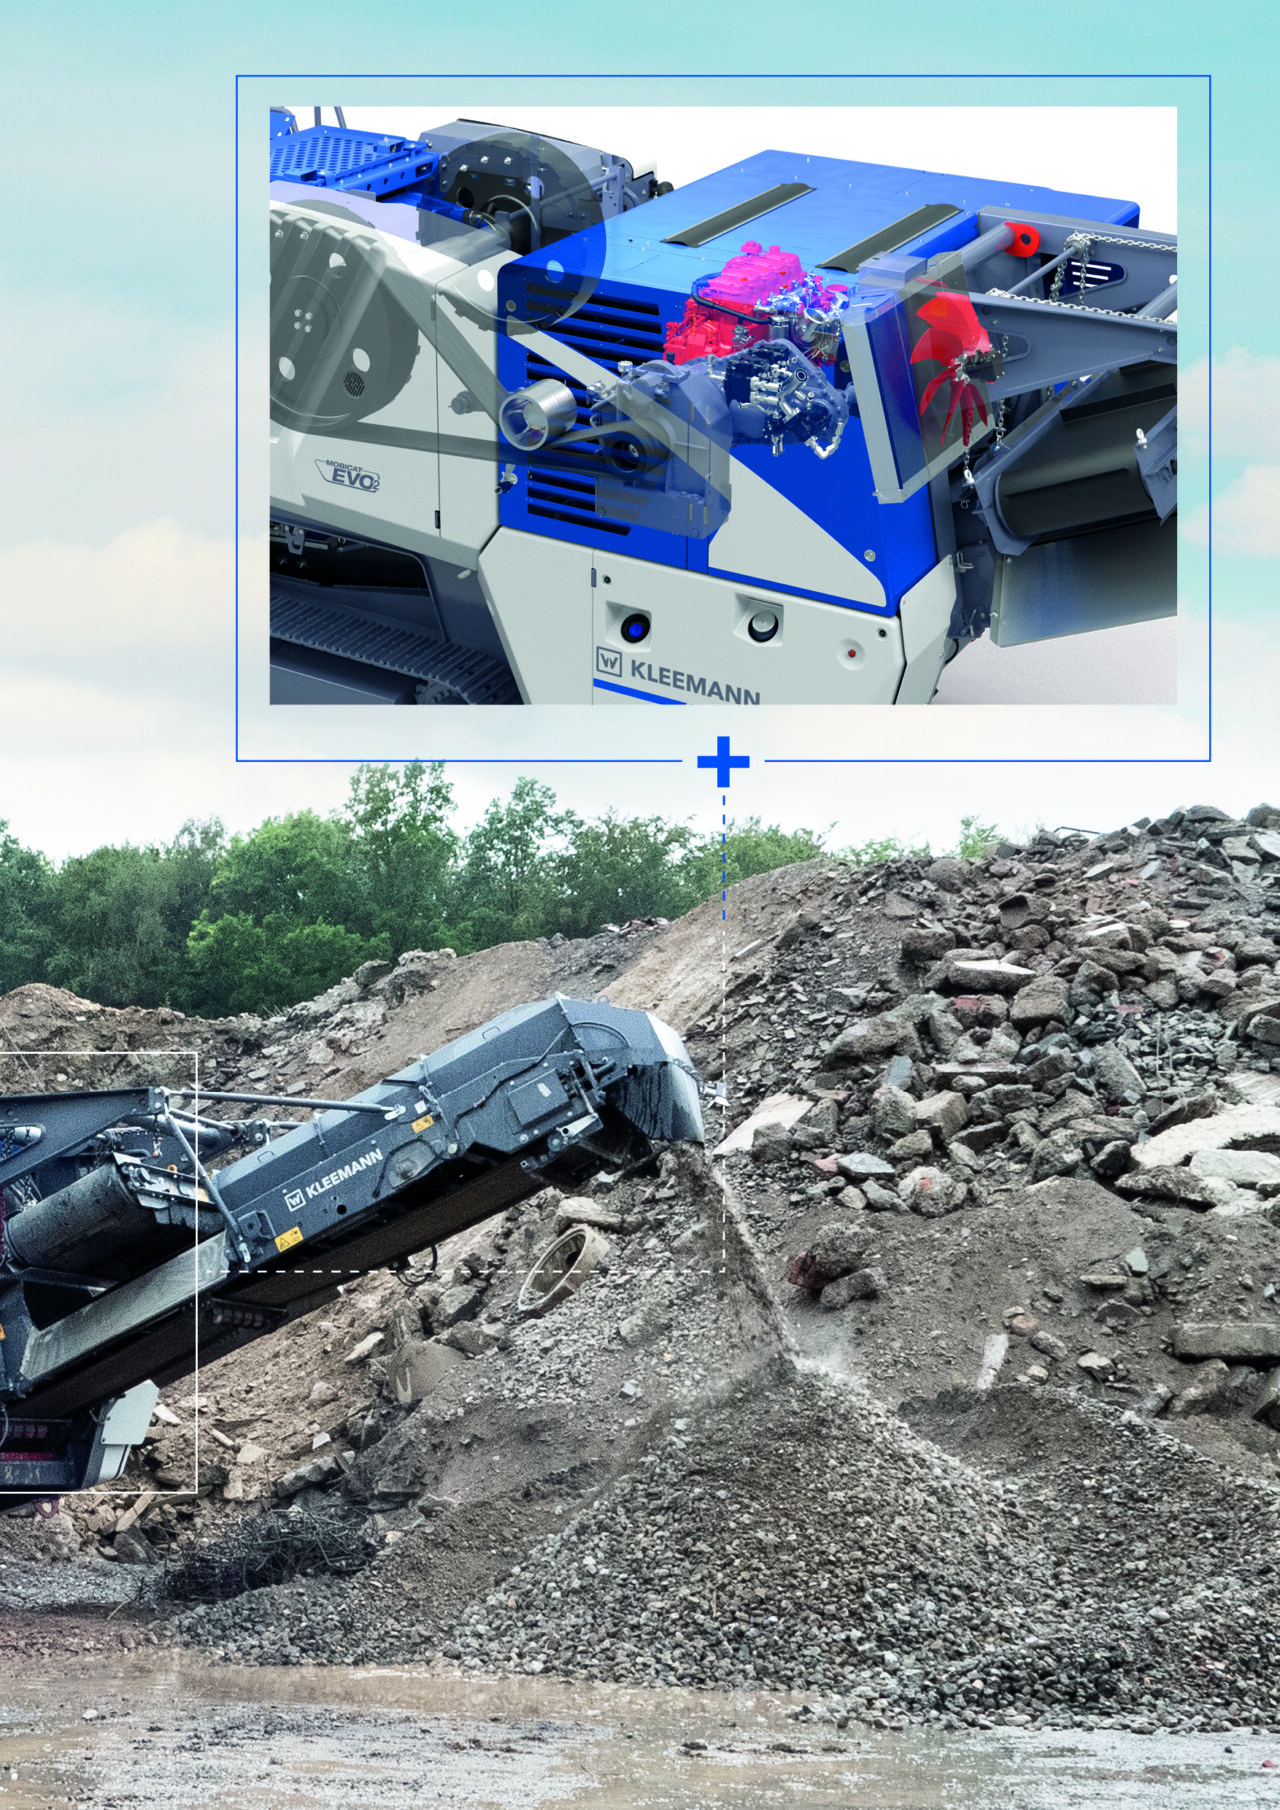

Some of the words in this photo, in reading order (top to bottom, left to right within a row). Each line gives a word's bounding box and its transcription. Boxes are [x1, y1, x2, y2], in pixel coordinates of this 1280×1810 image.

[325, 459, 363, 473] MOBICAT
[631, 658, 761, 705] KLEEMANN
[305, 1148, 384, 1199] KLEEMANN
